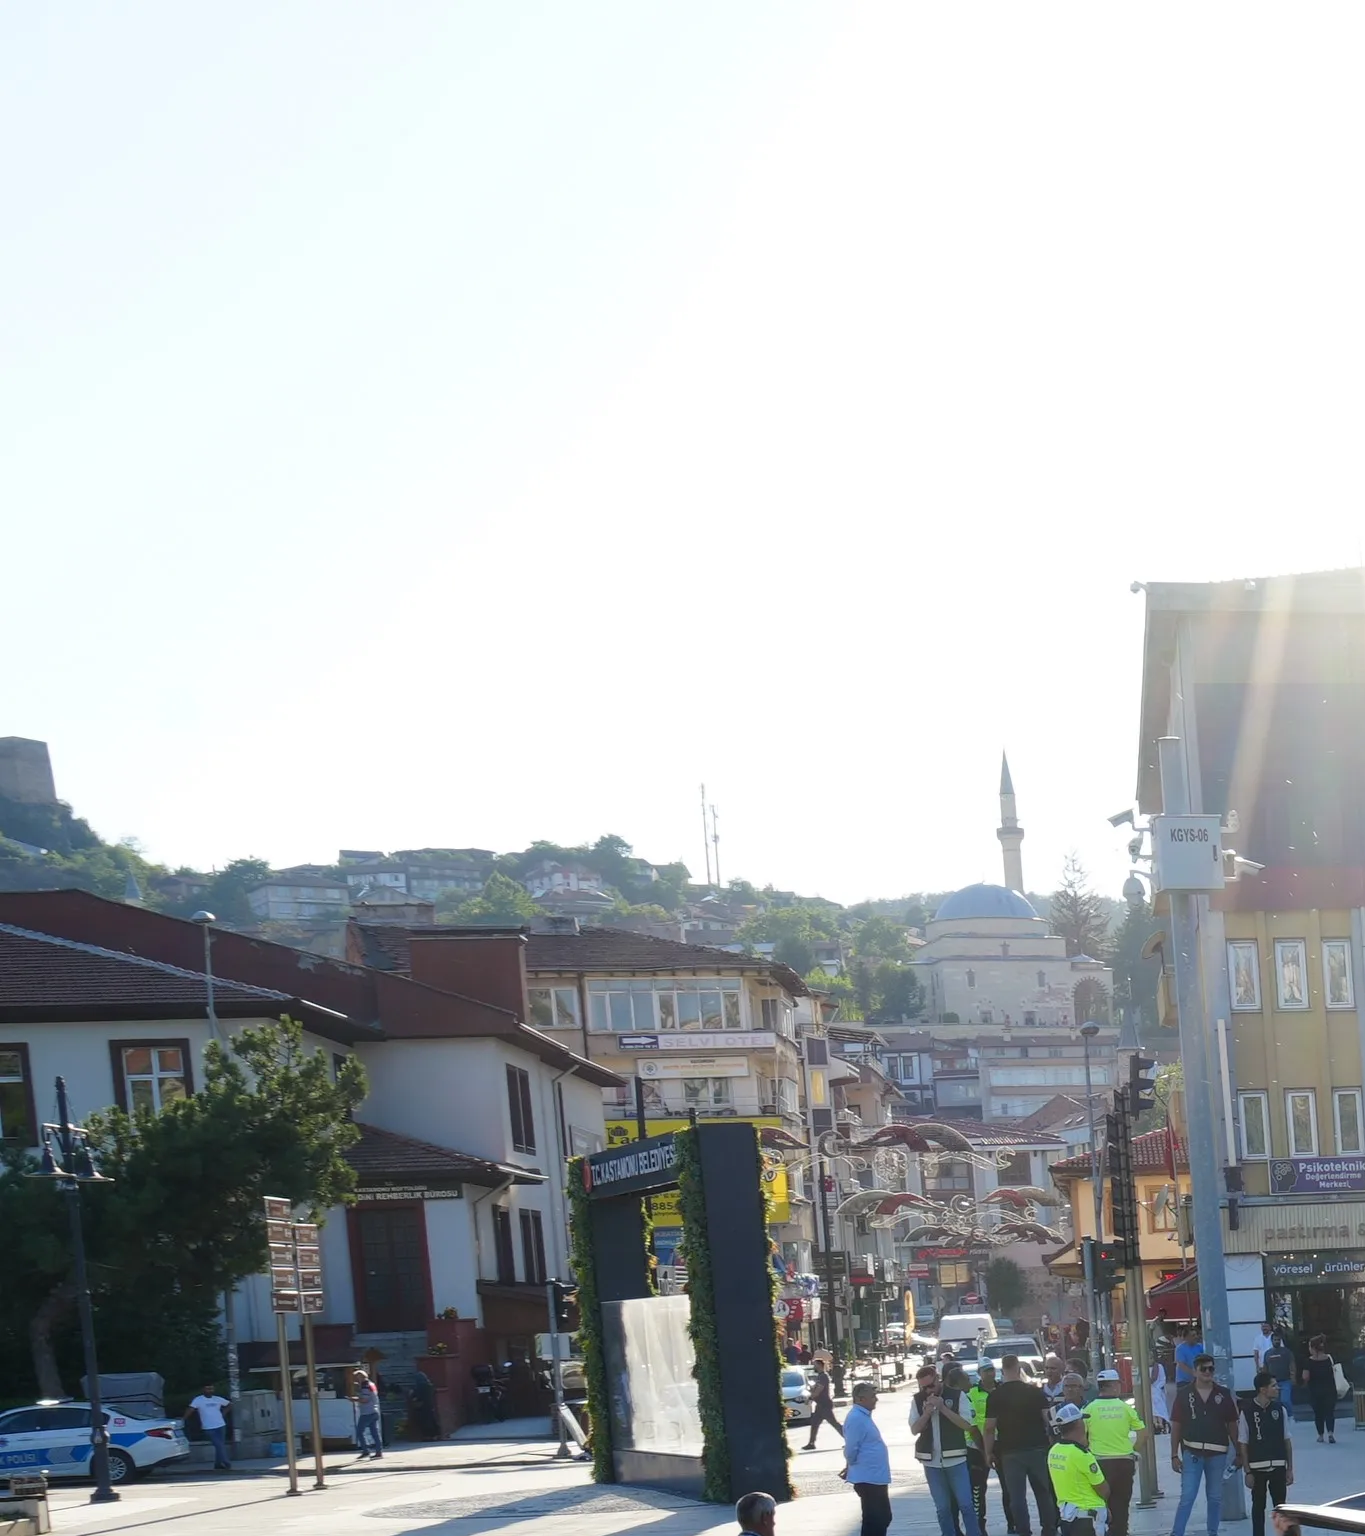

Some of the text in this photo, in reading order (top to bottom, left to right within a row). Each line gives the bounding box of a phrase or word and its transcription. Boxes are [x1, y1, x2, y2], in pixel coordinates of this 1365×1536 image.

[1170, 828, 1208, 842] KGYS-06
[726, 1036, 773, 1047] OTEL
[1299, 1161, 1365, 1173] Psikoteknik
[1305, 1173, 1361, 1181] Değerlendirme
[1264, 1222, 1350, 1243] pastırma
[1273, 1261, 1365, 1276] yöresel ürünler
